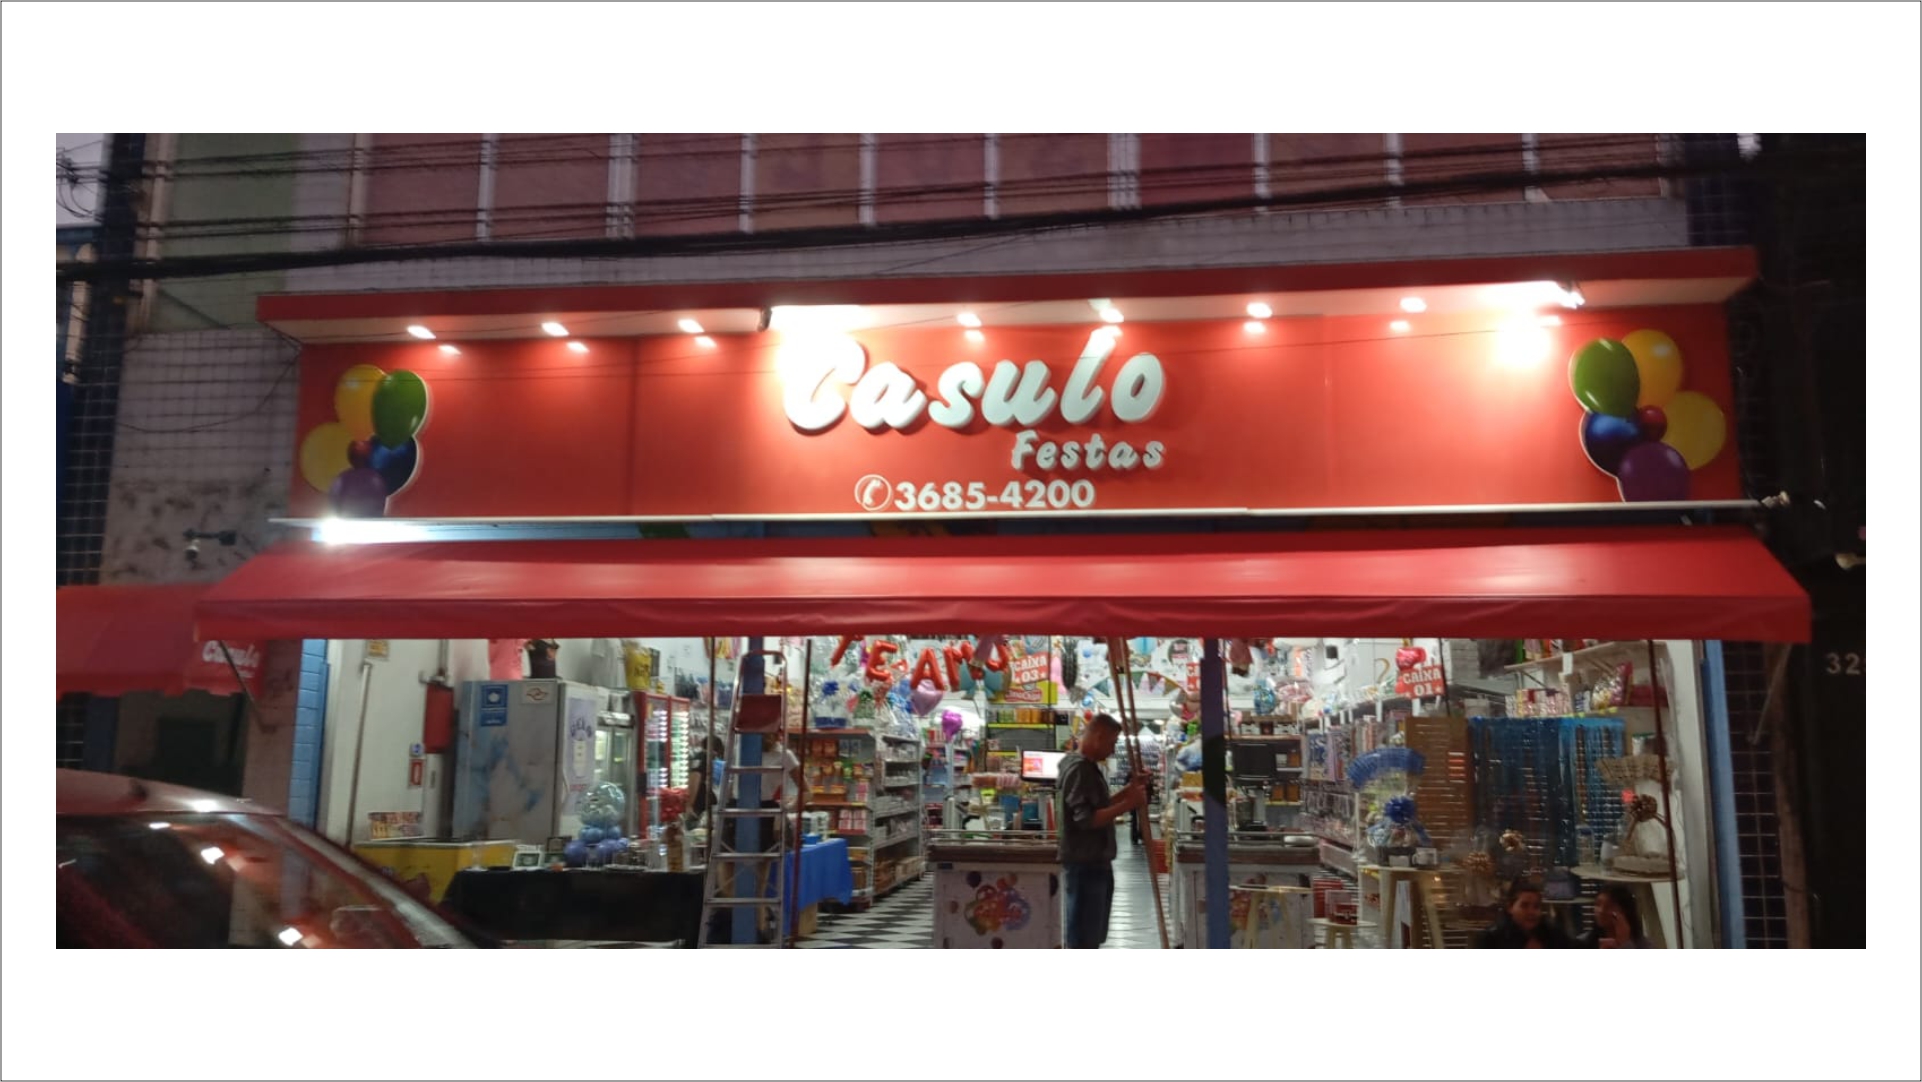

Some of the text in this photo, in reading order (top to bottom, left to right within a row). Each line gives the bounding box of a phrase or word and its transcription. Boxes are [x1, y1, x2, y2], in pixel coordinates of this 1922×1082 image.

[782, 326, 1165, 430] Casulo
[1011, 430, 1166, 470] Festas
[895, 479, 1096, 511] 3685-4200
[1011, 654, 1048, 671] CAIXA
[1826, 653, 1860, 675] 32
[1021, 669, 1040, 683] 03
[1402, 667, 1441, 685] CAIXA
[1413, 682, 1433, 697] 01
